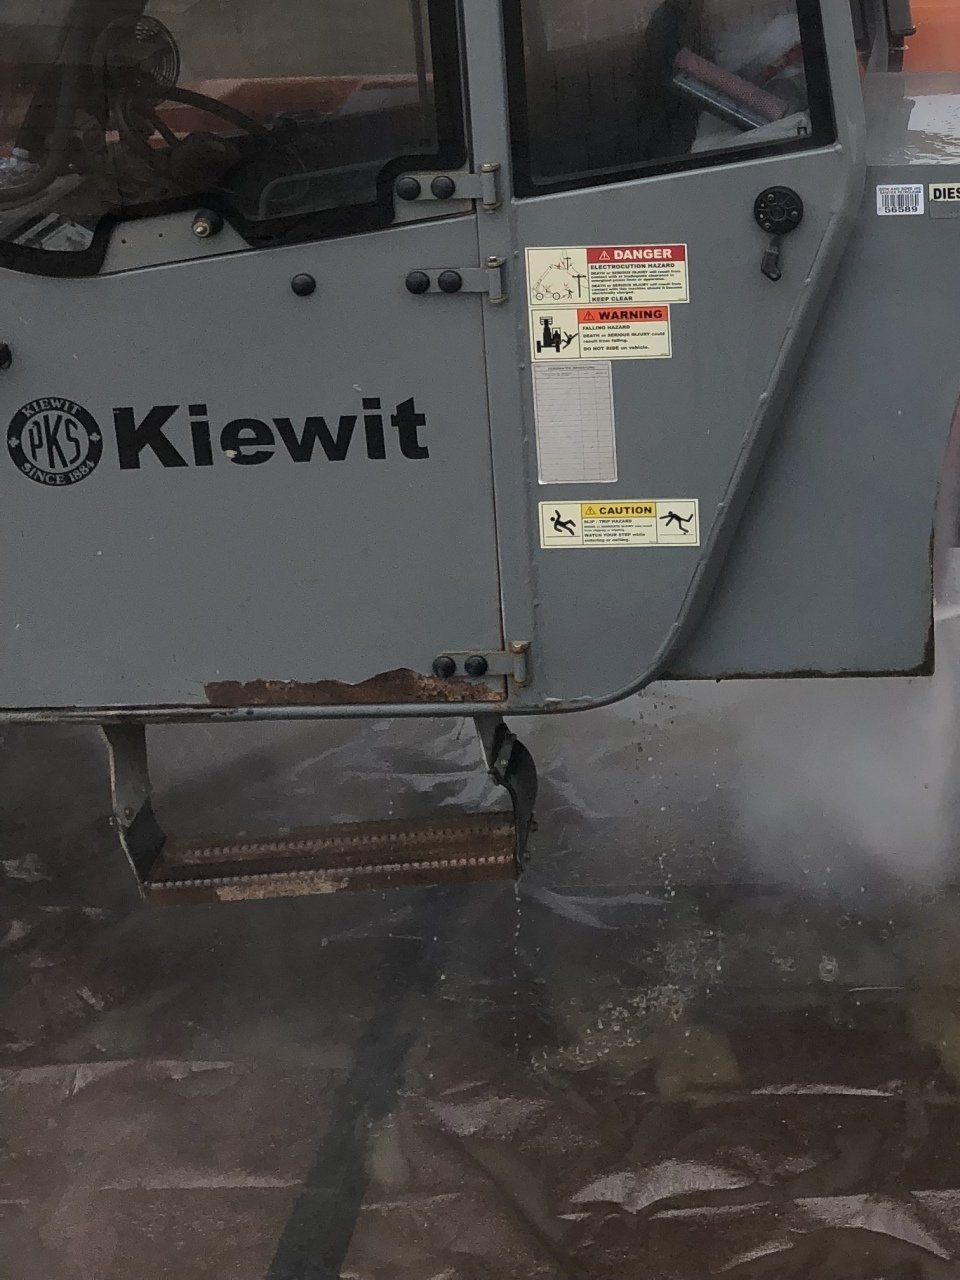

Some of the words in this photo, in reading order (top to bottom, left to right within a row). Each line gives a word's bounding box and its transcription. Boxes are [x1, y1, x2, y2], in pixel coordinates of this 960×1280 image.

[614, 248, 672, 260] DANGER
[599, 310, 662, 320] WARNING
[22, 399, 81, 417] KIEWIT
[28, 414, 81, 468] PKS
[112, 396, 430, 470] Kiewit
[22, 462, 66, 485] SINCE
[69, 460, 94, 482] 1884
[599, 506, 652, 515] CAUTION
